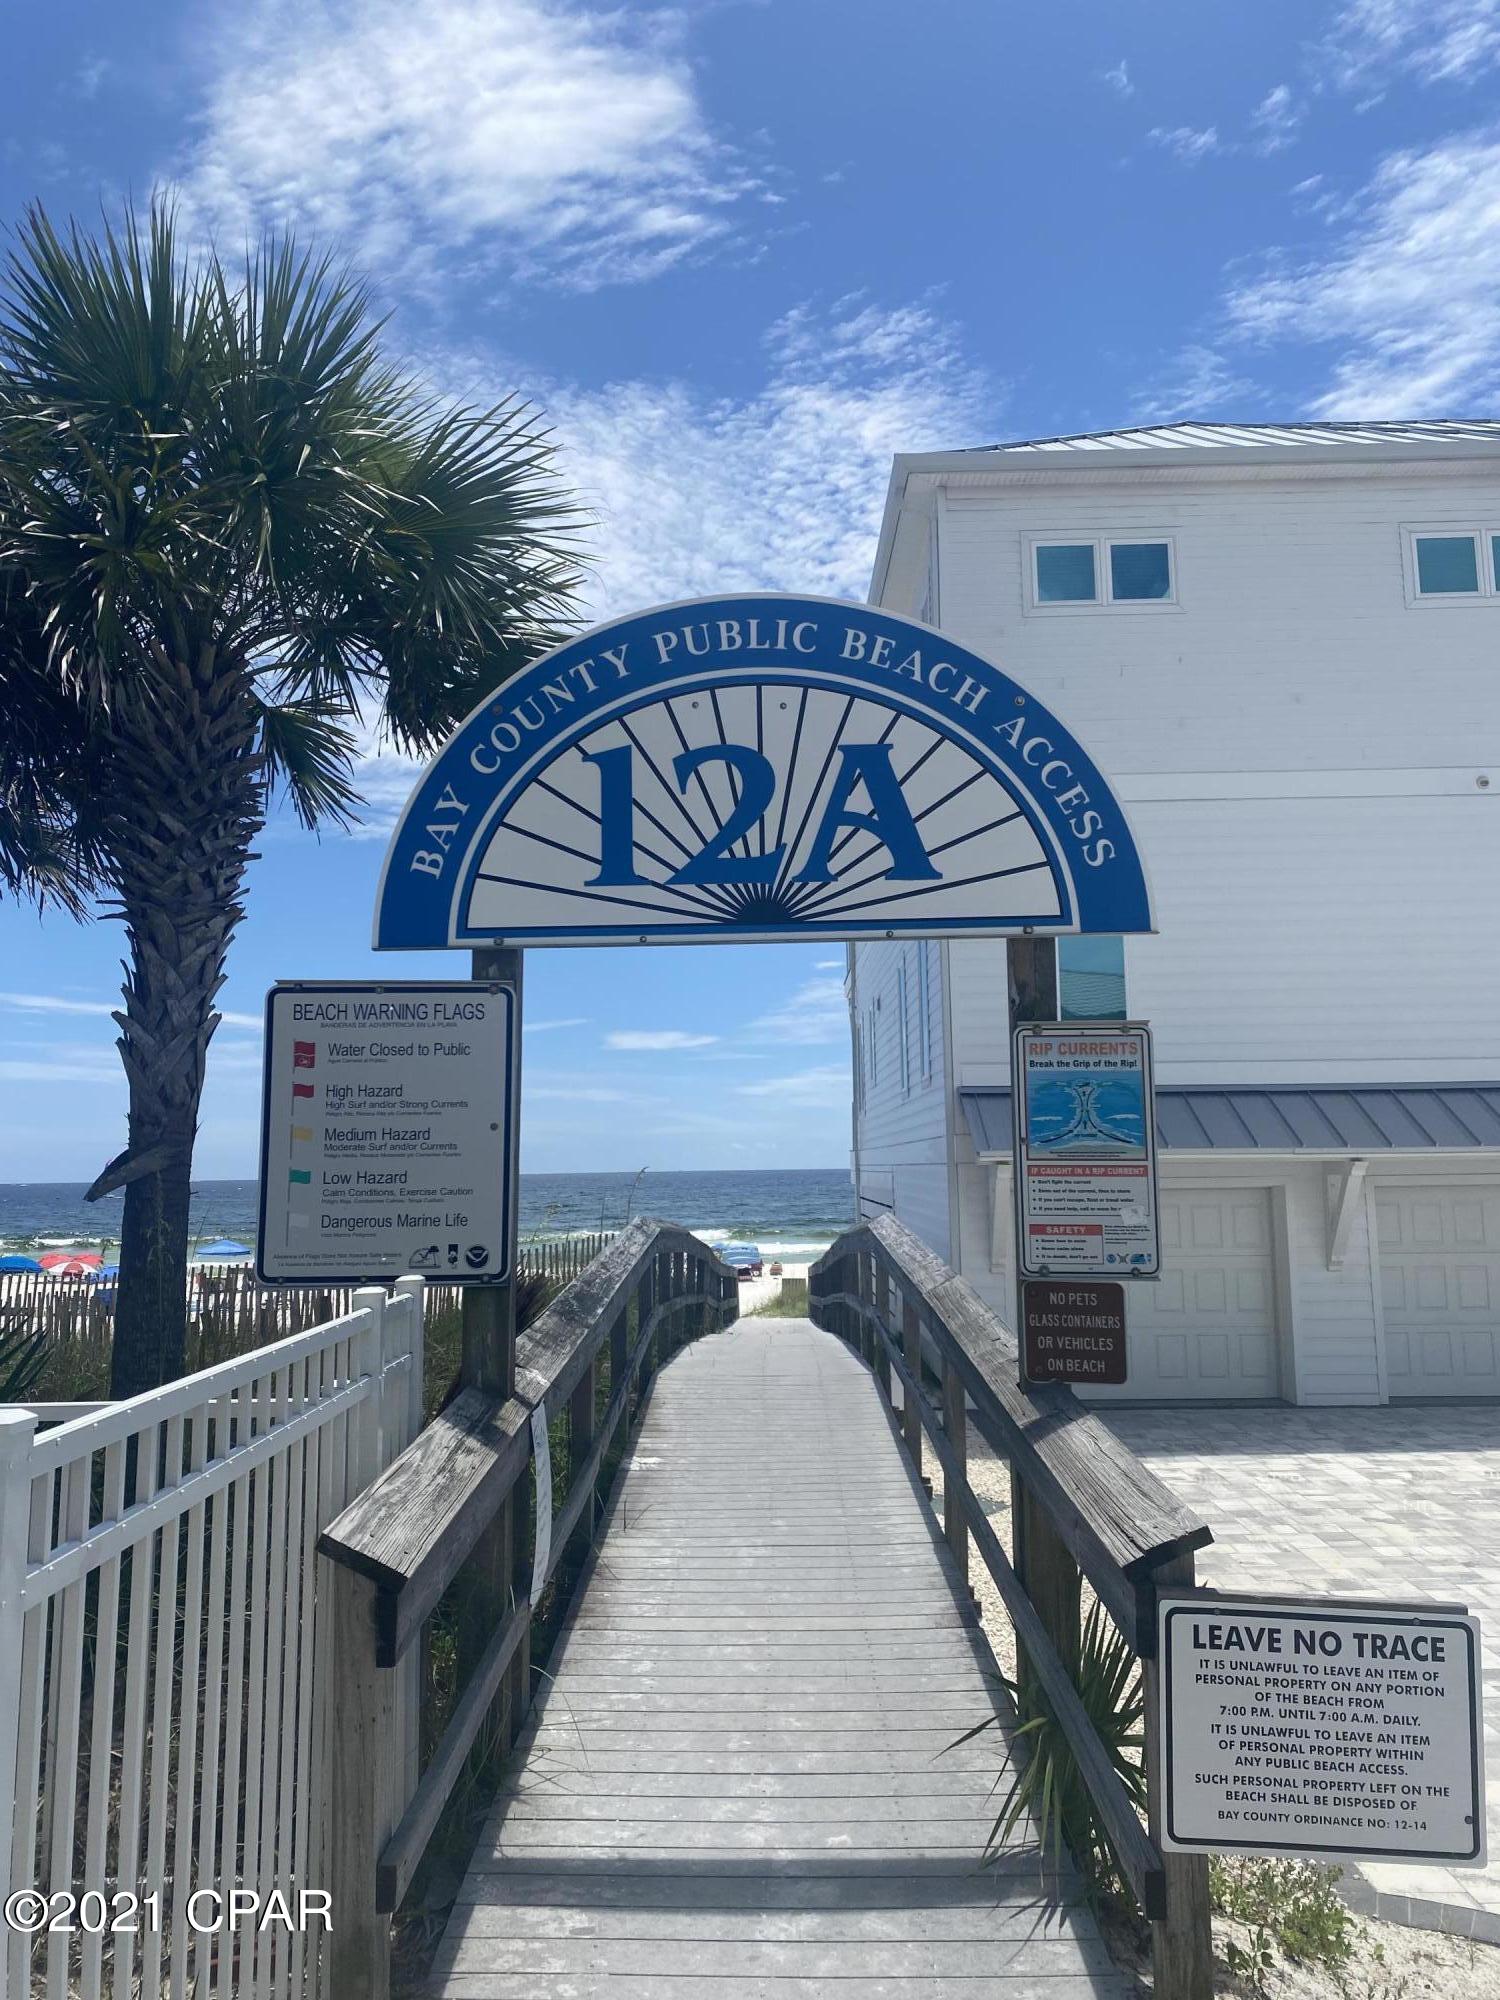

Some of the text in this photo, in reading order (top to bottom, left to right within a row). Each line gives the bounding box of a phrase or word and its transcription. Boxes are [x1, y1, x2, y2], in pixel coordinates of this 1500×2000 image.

[409, 618, 1118, 880] BAY COUNTY PUBLIC BEACH ACCESS
[582, 742, 944, 888] 12A
[293, 1003, 485, 1020] BEACH WARNING FLAGS
[328, 1043, 470, 1056] Water Closed to Public
[1029, 1042, 1137, 1056] RIP CURRENTS
[1029, 1060, 1137, 1070] Break the Grip of the Rip!
[326, 1084, 402, 1100] High Hazard
[326, 1101, 345, 1110] High
[348, 1101, 366, 1109] Surf
[400, 1101, 428, 1110] Strong
[324, 1128, 430, 1141] Medium Hazard
[323, 1171, 407, 1185] Low Hazard
[322, 1189, 345, 1197] Calm
[348, 1189, 395, 1197] Conditions,
[400, 1188, 437, 1196] Exercise
[321, 1214, 469, 1231] Dangerous Marine Life
[1049, 1292, 1098, 1306] NO PETS
[1029, 1314, 1120, 1328] GLASS CONTAINERS
[1038, 1336, 1113, 1351] OR VEHICLES
[1048, 1359, 1105, 1372] ON BEACH
[1193, 1624, 1445, 1662] LEAVE NO TRACE
[1200, 1659, 1439, 1681] IT IS UNLAWFUL TO LEAVE AN ITEM OF
[1196, 1674, 1444, 1696] PERSONAL PROPERTY ON ANY PORTION
[1255, 1692, 1384, 1708] OF THE BEACH FROM
[1220, 1706, 1420, 1726] 7:00 P.M. UNTIL 7:00 A.M. DAILY.
[1211, 1724, 1430, 1745] IT IS UNLAWFUL TO LEAVE AN ITEM
[1219, 1740, 1423, 1760] OF PERSONAL PROPERTY WITHIN
[1235, 1756, 1408, 1775] ANY PUBLIC BEACH ACCESS.
[1195, 1774, 1449, 1796] SUCH PERSONAL PROPERTY LEFT ON THE
[1226, 1791, 1416, 1810] BEACH SHALL BE DISPOSED OF
[1219, 1811, 1426, 1830] BAY COUNTY ORDINANCE NO: 12-14
